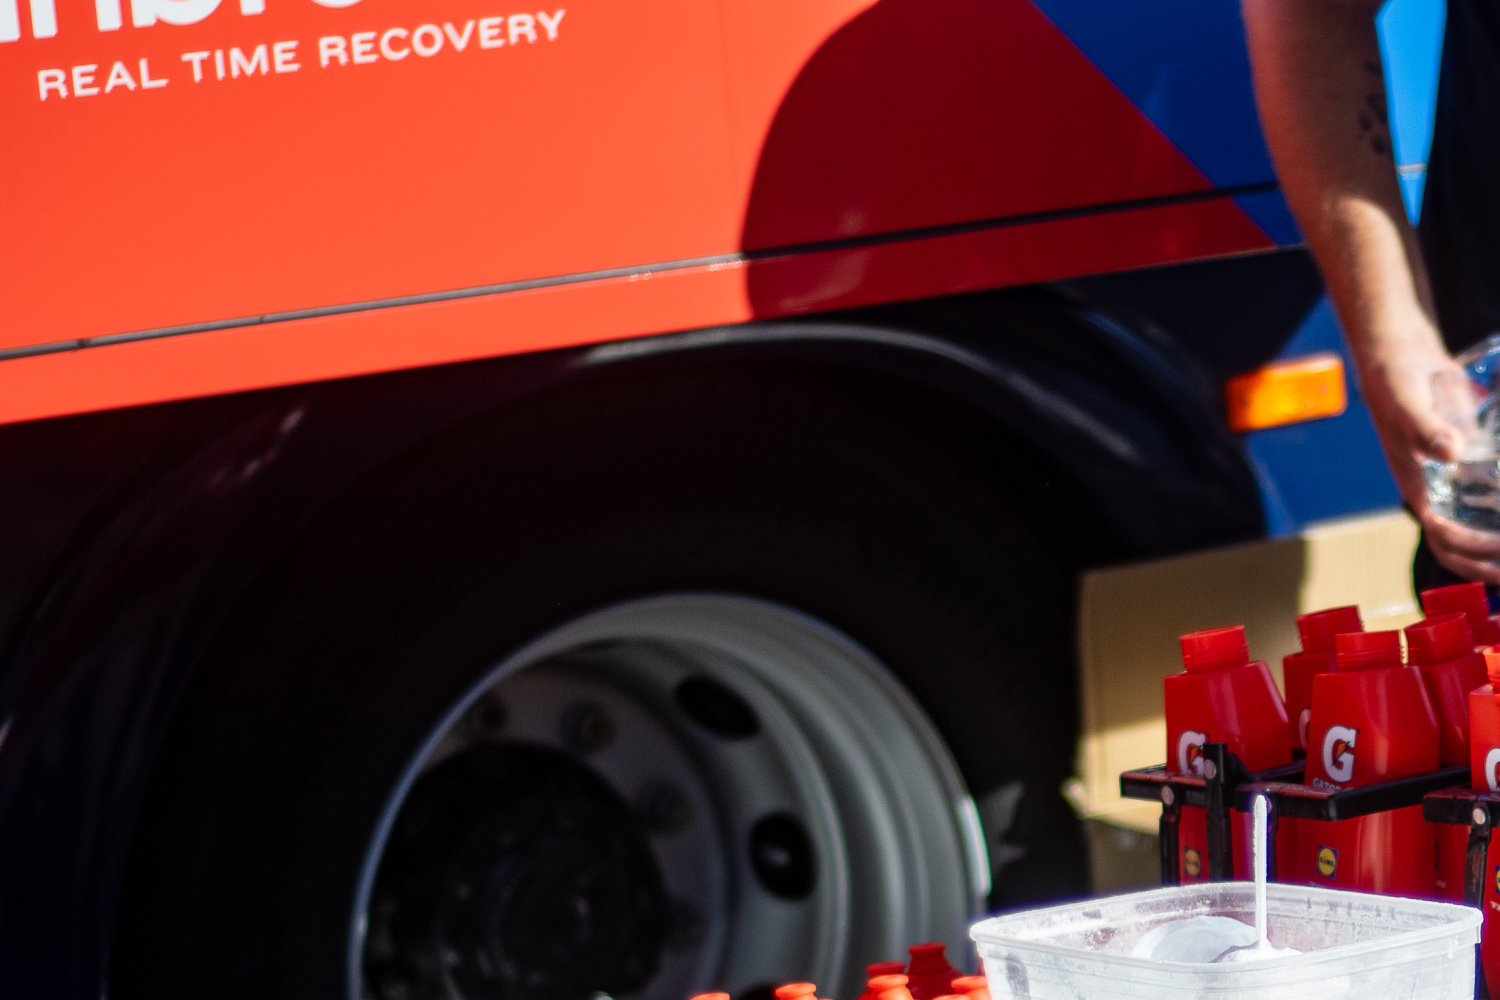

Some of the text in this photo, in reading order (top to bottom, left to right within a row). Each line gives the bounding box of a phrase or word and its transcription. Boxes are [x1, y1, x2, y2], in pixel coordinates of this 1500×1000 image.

[38, 58, 169, 101] REAL
[182, 40, 302, 84] TIME
[319, 8, 566, 69] RECOVERY
[1322, 724, 1357, 783] G
